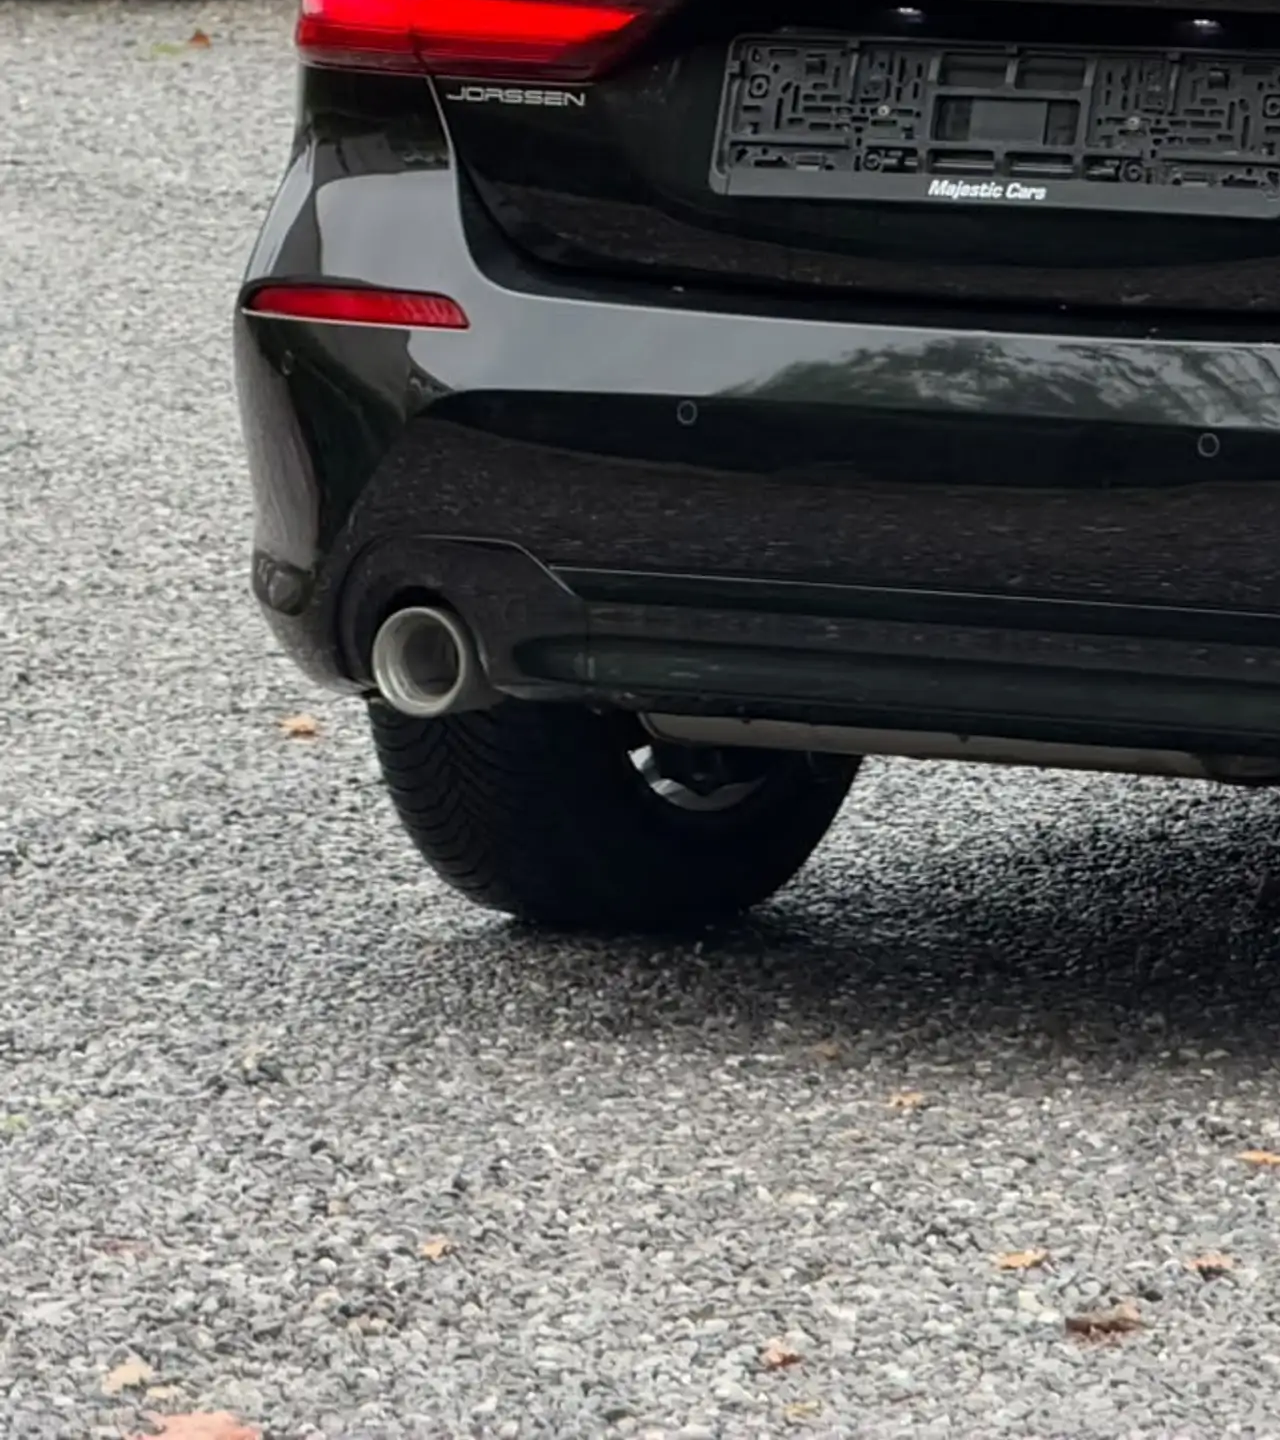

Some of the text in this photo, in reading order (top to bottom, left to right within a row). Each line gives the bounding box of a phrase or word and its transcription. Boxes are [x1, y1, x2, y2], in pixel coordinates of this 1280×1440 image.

[445, 86, 586, 107] JORSSEN
[928, 179, 1047, 200] Majestic Cars
